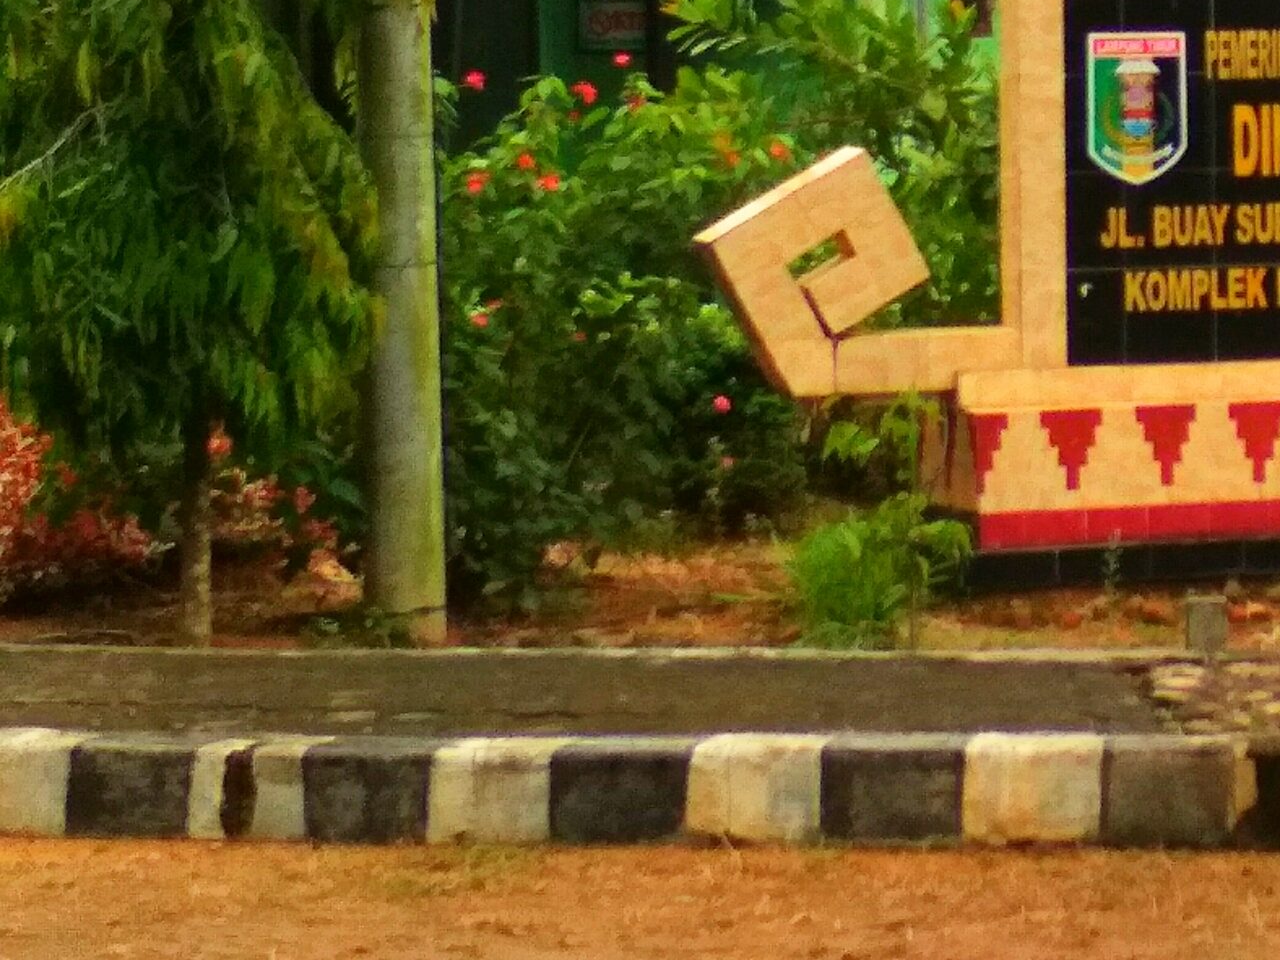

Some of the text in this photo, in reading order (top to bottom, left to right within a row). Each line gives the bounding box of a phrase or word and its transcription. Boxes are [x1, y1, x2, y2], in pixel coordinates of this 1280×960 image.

[1099, 207, 1144, 249] JL.
[1152, 206, 1229, 247] BUAY
[1124, 266, 1268, 311] KOMPLEK
